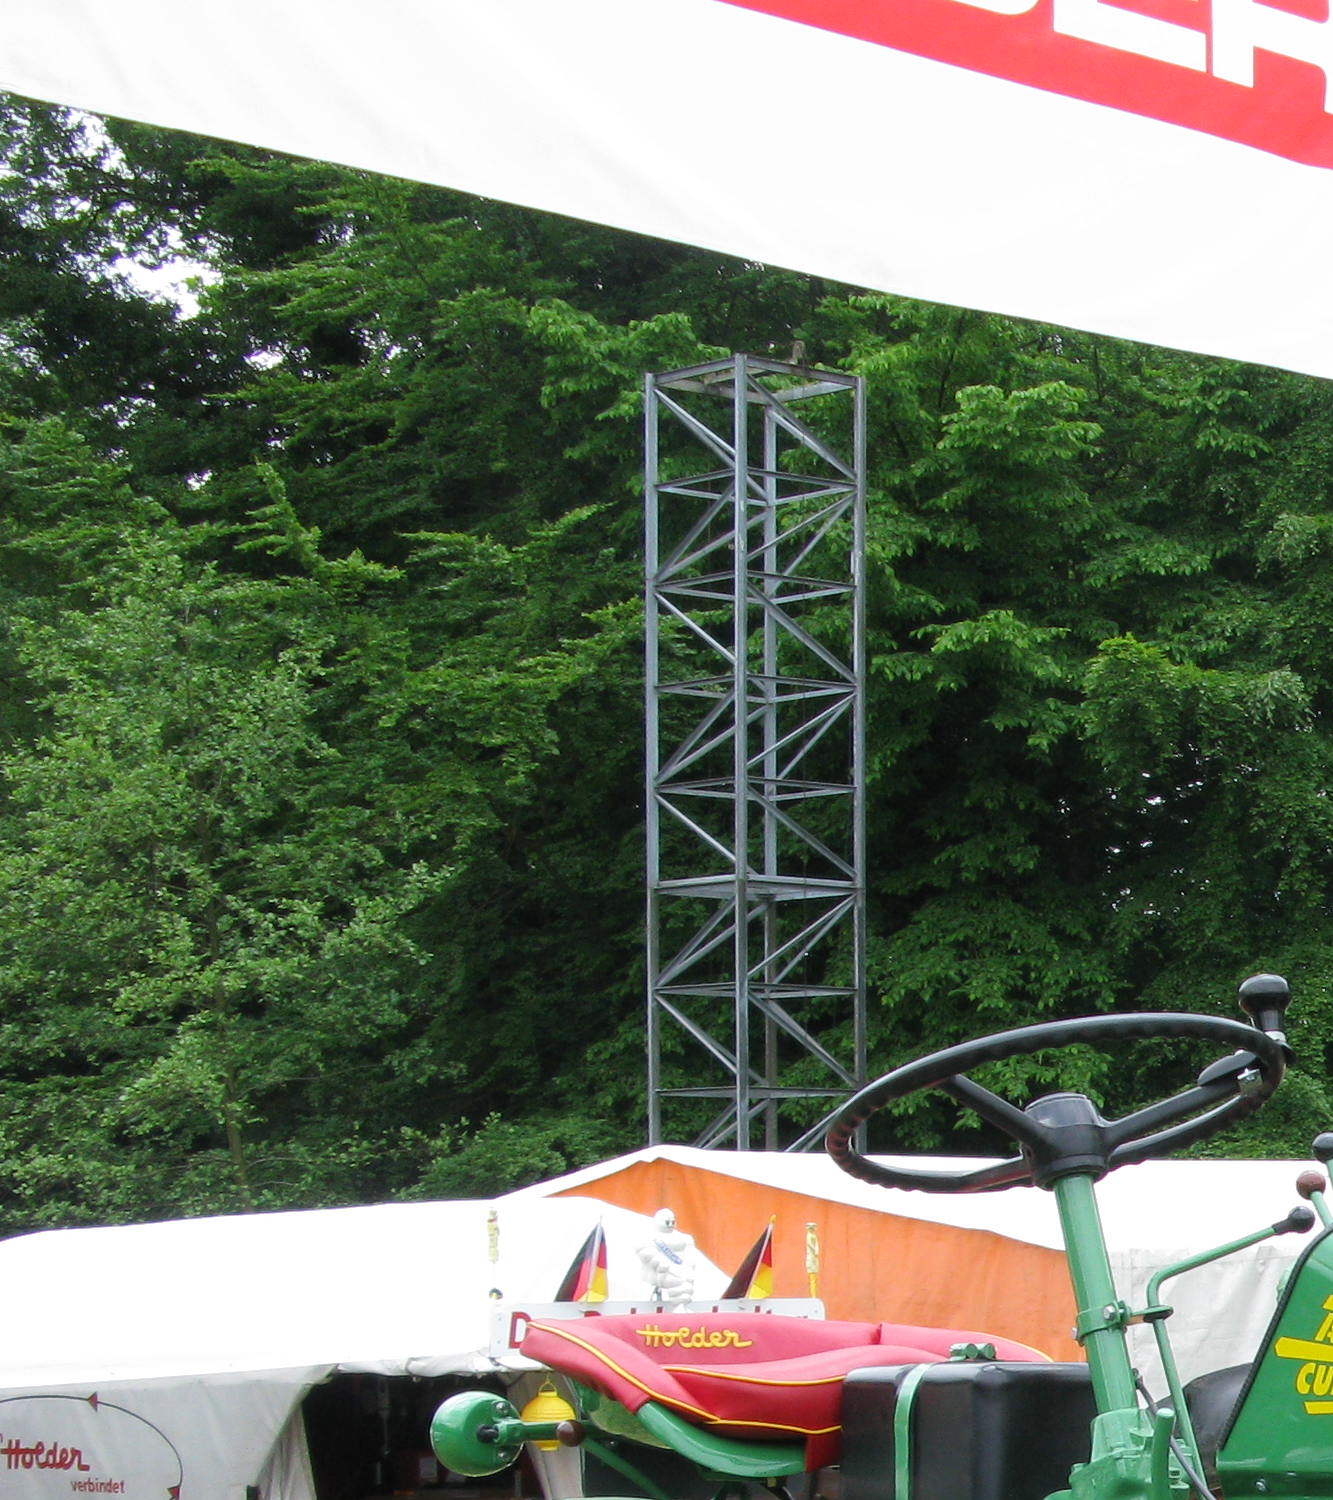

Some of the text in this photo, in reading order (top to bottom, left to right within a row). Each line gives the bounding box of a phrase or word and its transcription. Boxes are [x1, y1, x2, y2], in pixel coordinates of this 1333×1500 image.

[635, 1323, 753, 1349] Holder
[0, 1439, 90, 1471] Holder
[70, 1478, 126, 1494] verbindet
